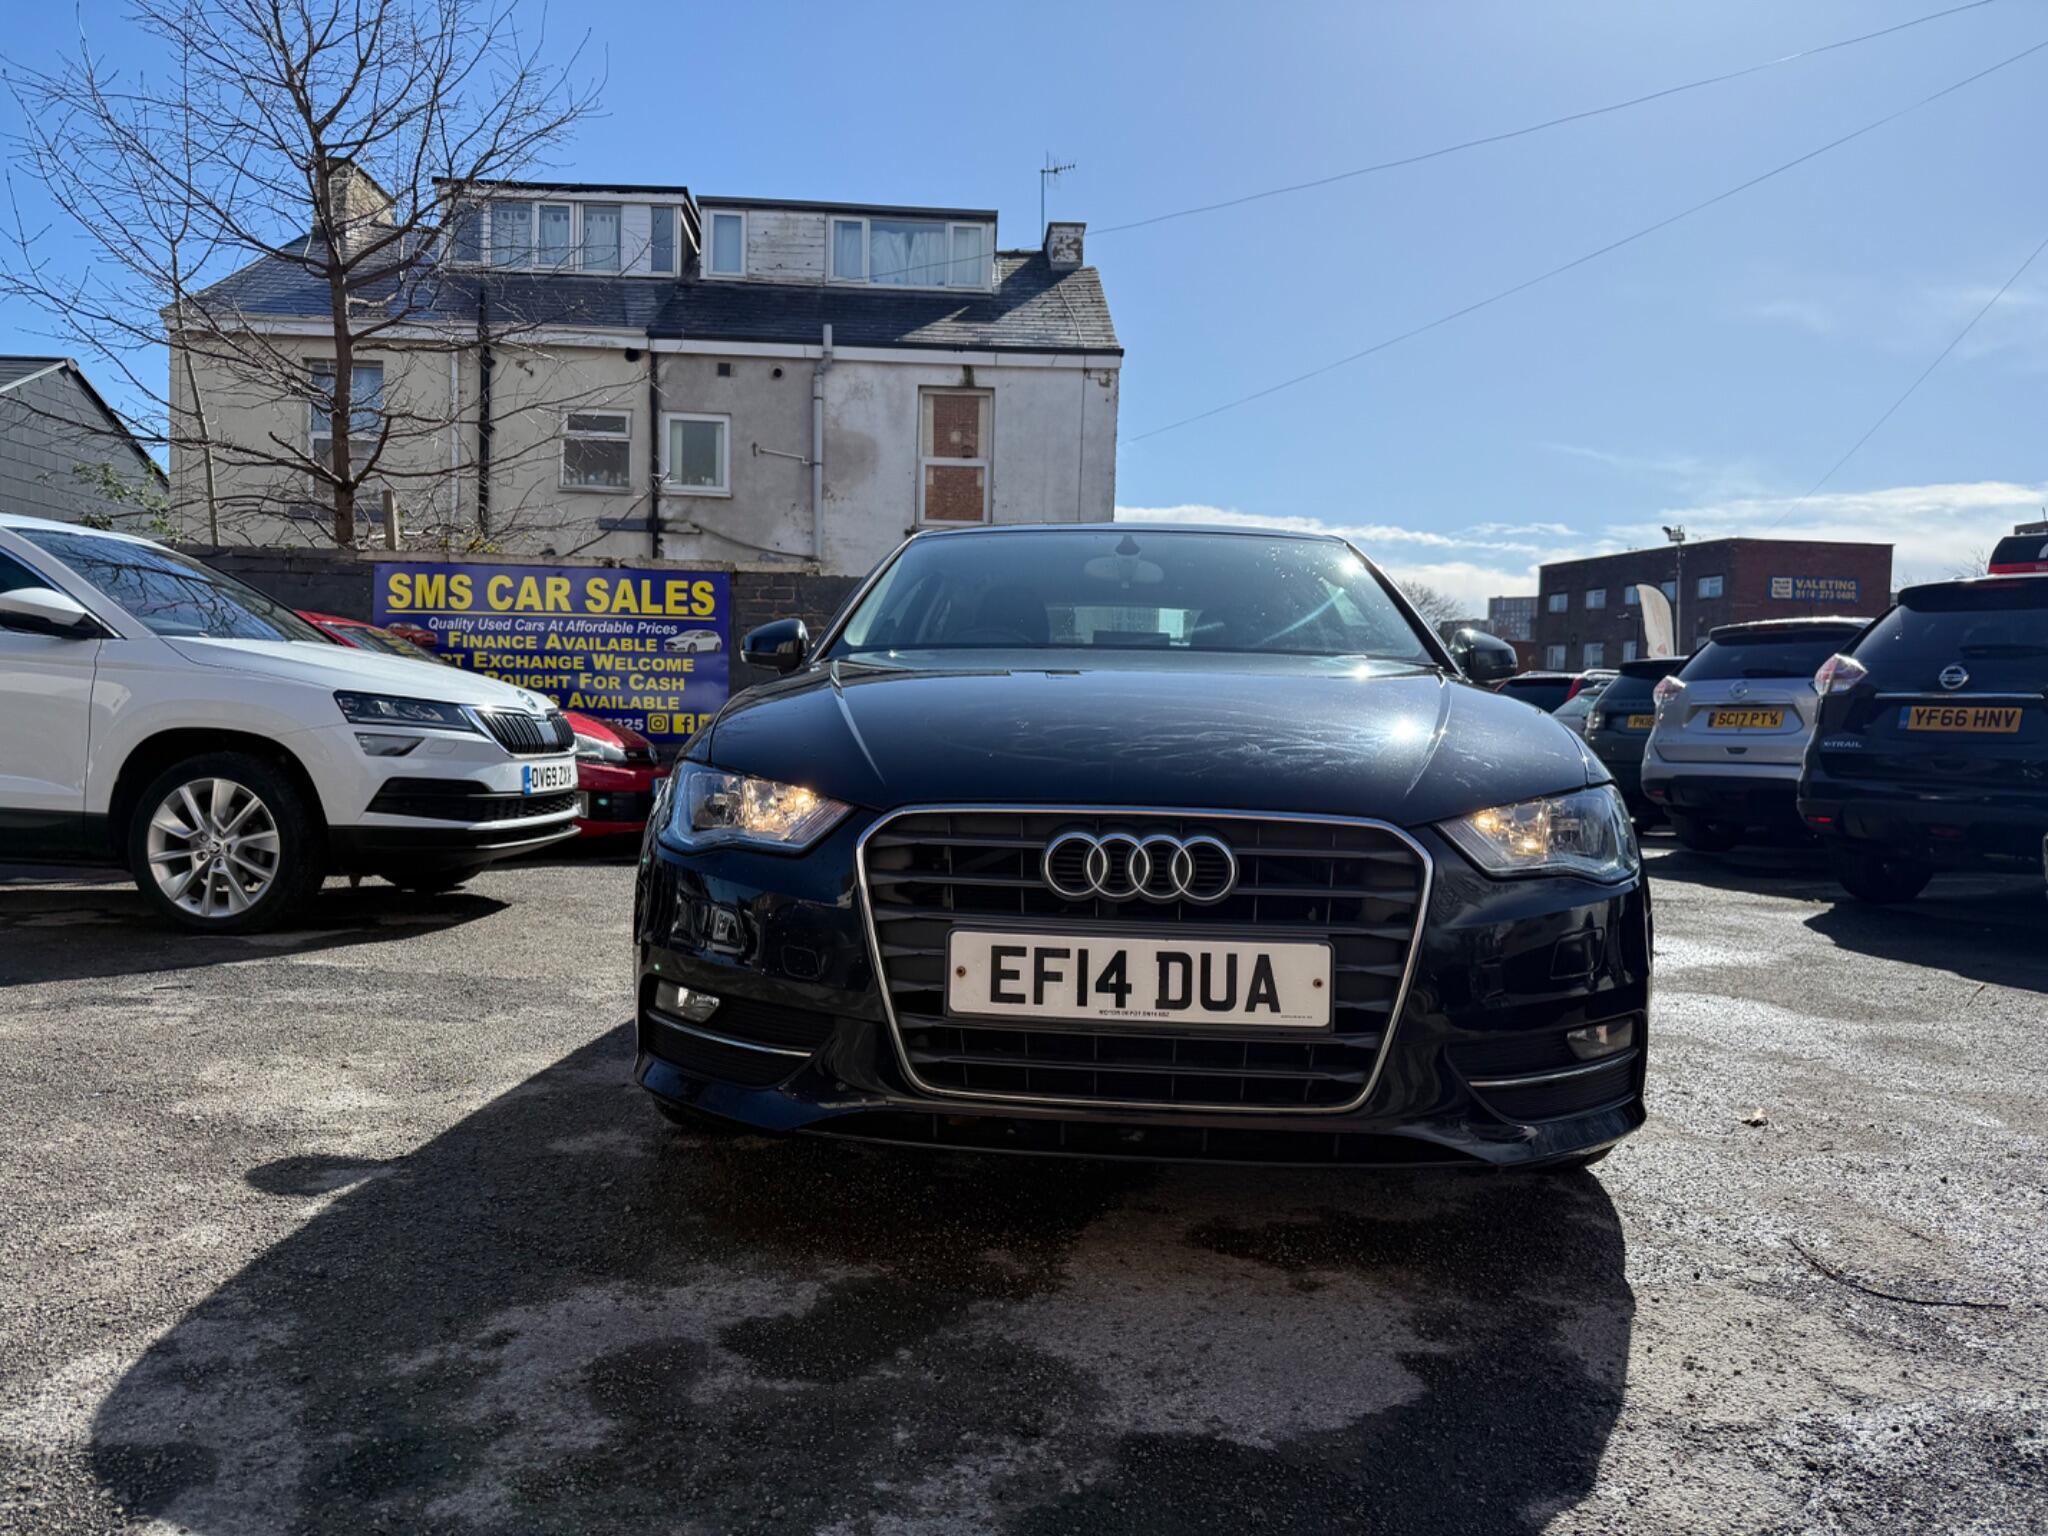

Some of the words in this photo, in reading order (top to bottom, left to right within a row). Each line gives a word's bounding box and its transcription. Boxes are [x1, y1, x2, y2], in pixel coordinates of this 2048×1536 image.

[388, 573, 473, 610] SMS
[487, 575, 573, 613] CAR
[585, 577, 716, 615] SALES
[1796, 579, 1857, 590] VALETING
[428, 617, 475, 633] Quality
[478, 618, 512, 631] Used
[515, 619, 545, 632] Cars
[548, 620, 563, 632] At
[565, 620, 634, 633] Affordable
[637, 621, 678, 635] Prices
[448, 631, 537, 649] FINANCE
[545, 633, 657, 652] AVAILABLE
[473, 651, 585, 669] EXCHANGE
[592, 653, 694, 672] WELCOME
[628, 673, 685, 691] CASH
[1718, 711, 1747, 726] SC17
[1914, 708, 1968, 728] YF66
[1973, 710, 2018, 728] HNV
[532, 767, 557, 788] OV69
[990, 945, 1132, 1009] EF14
[1155, 951, 1281, 1013] DUA
